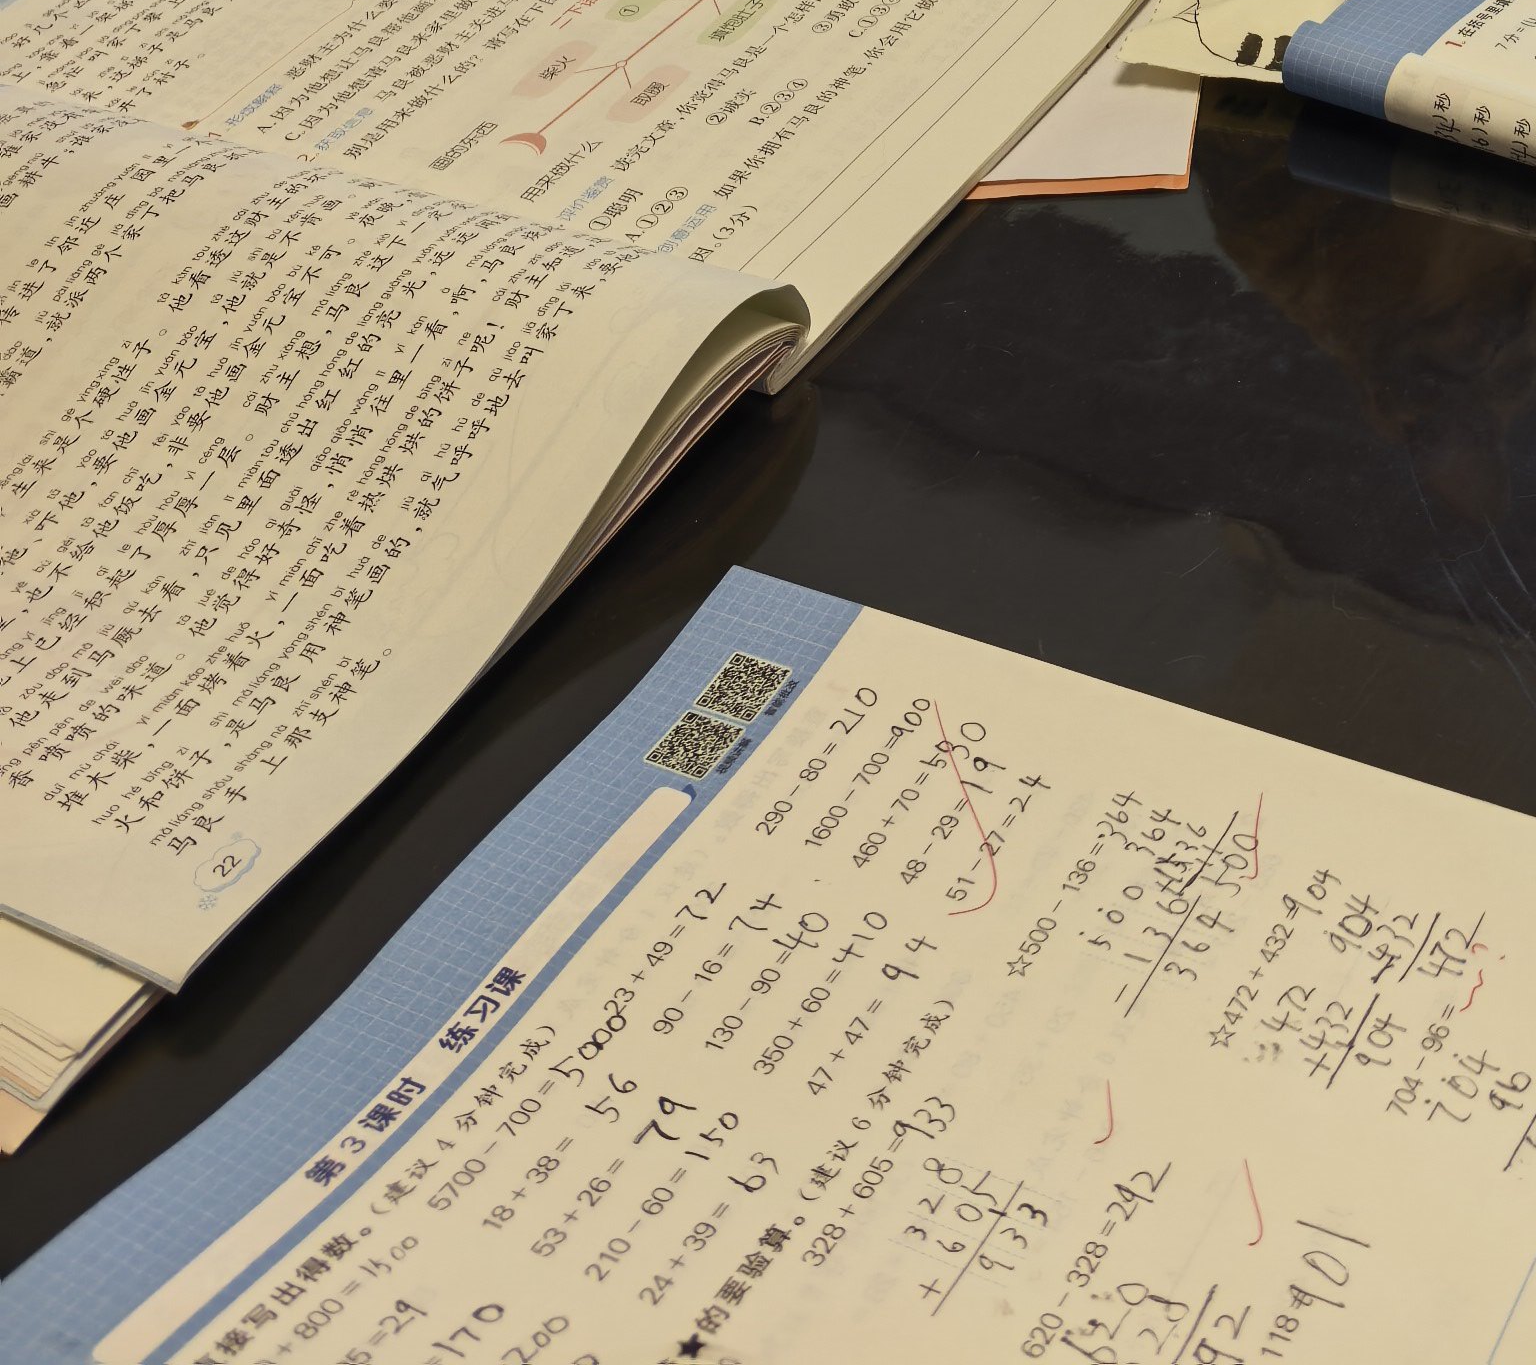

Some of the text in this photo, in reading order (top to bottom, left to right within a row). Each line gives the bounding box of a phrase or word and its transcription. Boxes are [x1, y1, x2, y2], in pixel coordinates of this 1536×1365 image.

[628, 79, 672, 107] 取暖
[426, 118, 500, 172] 画的东西
[517, 136, 605, 204] 用来做什么
[163, 642, 395, 859] 马良手上那支神笔。
[210, 850, 243, 881] 22
[297, 965, 531, 1187] 第3课时 练习课
